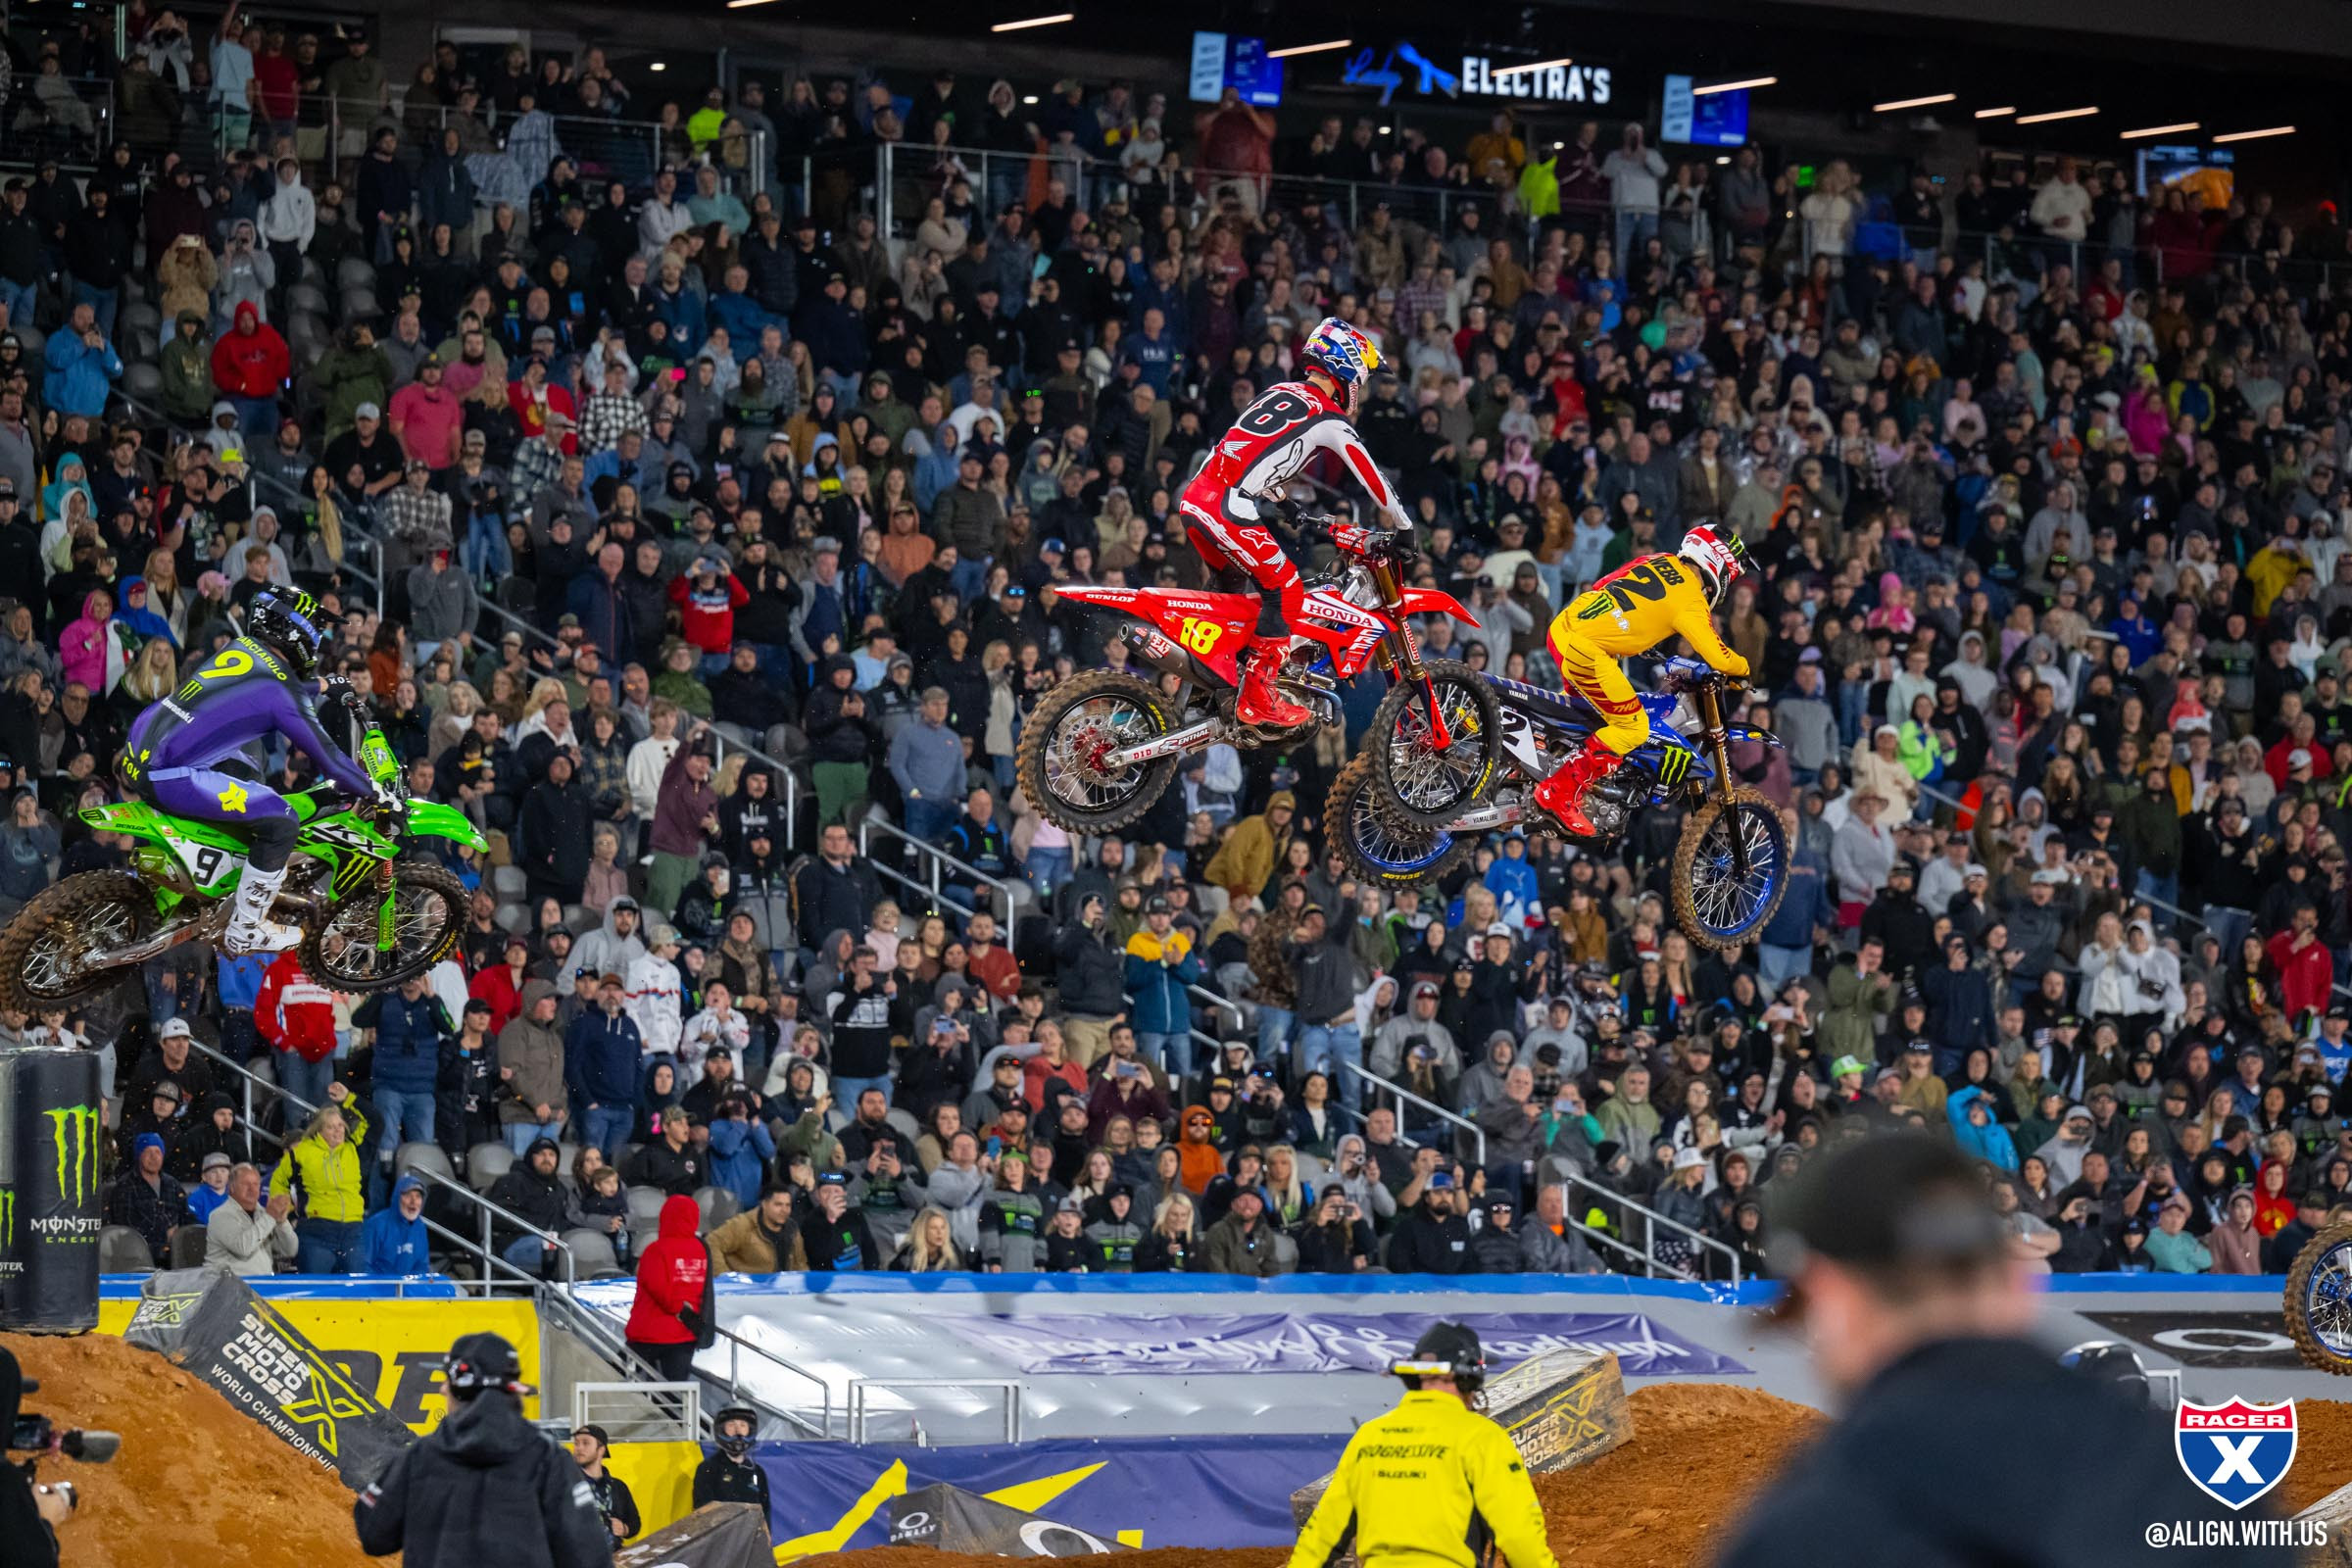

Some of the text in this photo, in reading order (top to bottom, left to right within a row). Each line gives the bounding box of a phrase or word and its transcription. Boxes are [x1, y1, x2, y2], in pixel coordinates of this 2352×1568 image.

[1462, 56, 1612, 104] ELECTRA'S
[1605, 564, 1667, 612] 2
[1648, 556, 1685, 586] WEBB
[1086, 593, 1137, 604] DUNLOP
[1167, 599, 1214, 612] HONDA
[1308, 603, 1373, 627] HONDA
[1179, 616, 1223, 656] 18
[1402, 621, 1421, 661] SHOWA
[198, 649, 254, 680] 9
[1508, 689, 1529, 702] YAMAHA
[122, 756, 140, 781] FOX
[1133, 748, 1152, 760] DID
[1470, 758, 1494, 800] DUNLOP
[116, 822, 147, 832] DUNLOP
[193, 847, 222, 886] 9
[235, 1331, 303, 1392] MOTO
[239, 1312, 312, 1382] SUPER
[211, 1364, 254, 1404] WORLD
[221, 1342, 298, 1405] CROSS
[1356, 1445, 1448, 1462] PROGRESSIVE
[1547, 1434, 1612, 1475] CHAMPIONSHIP
